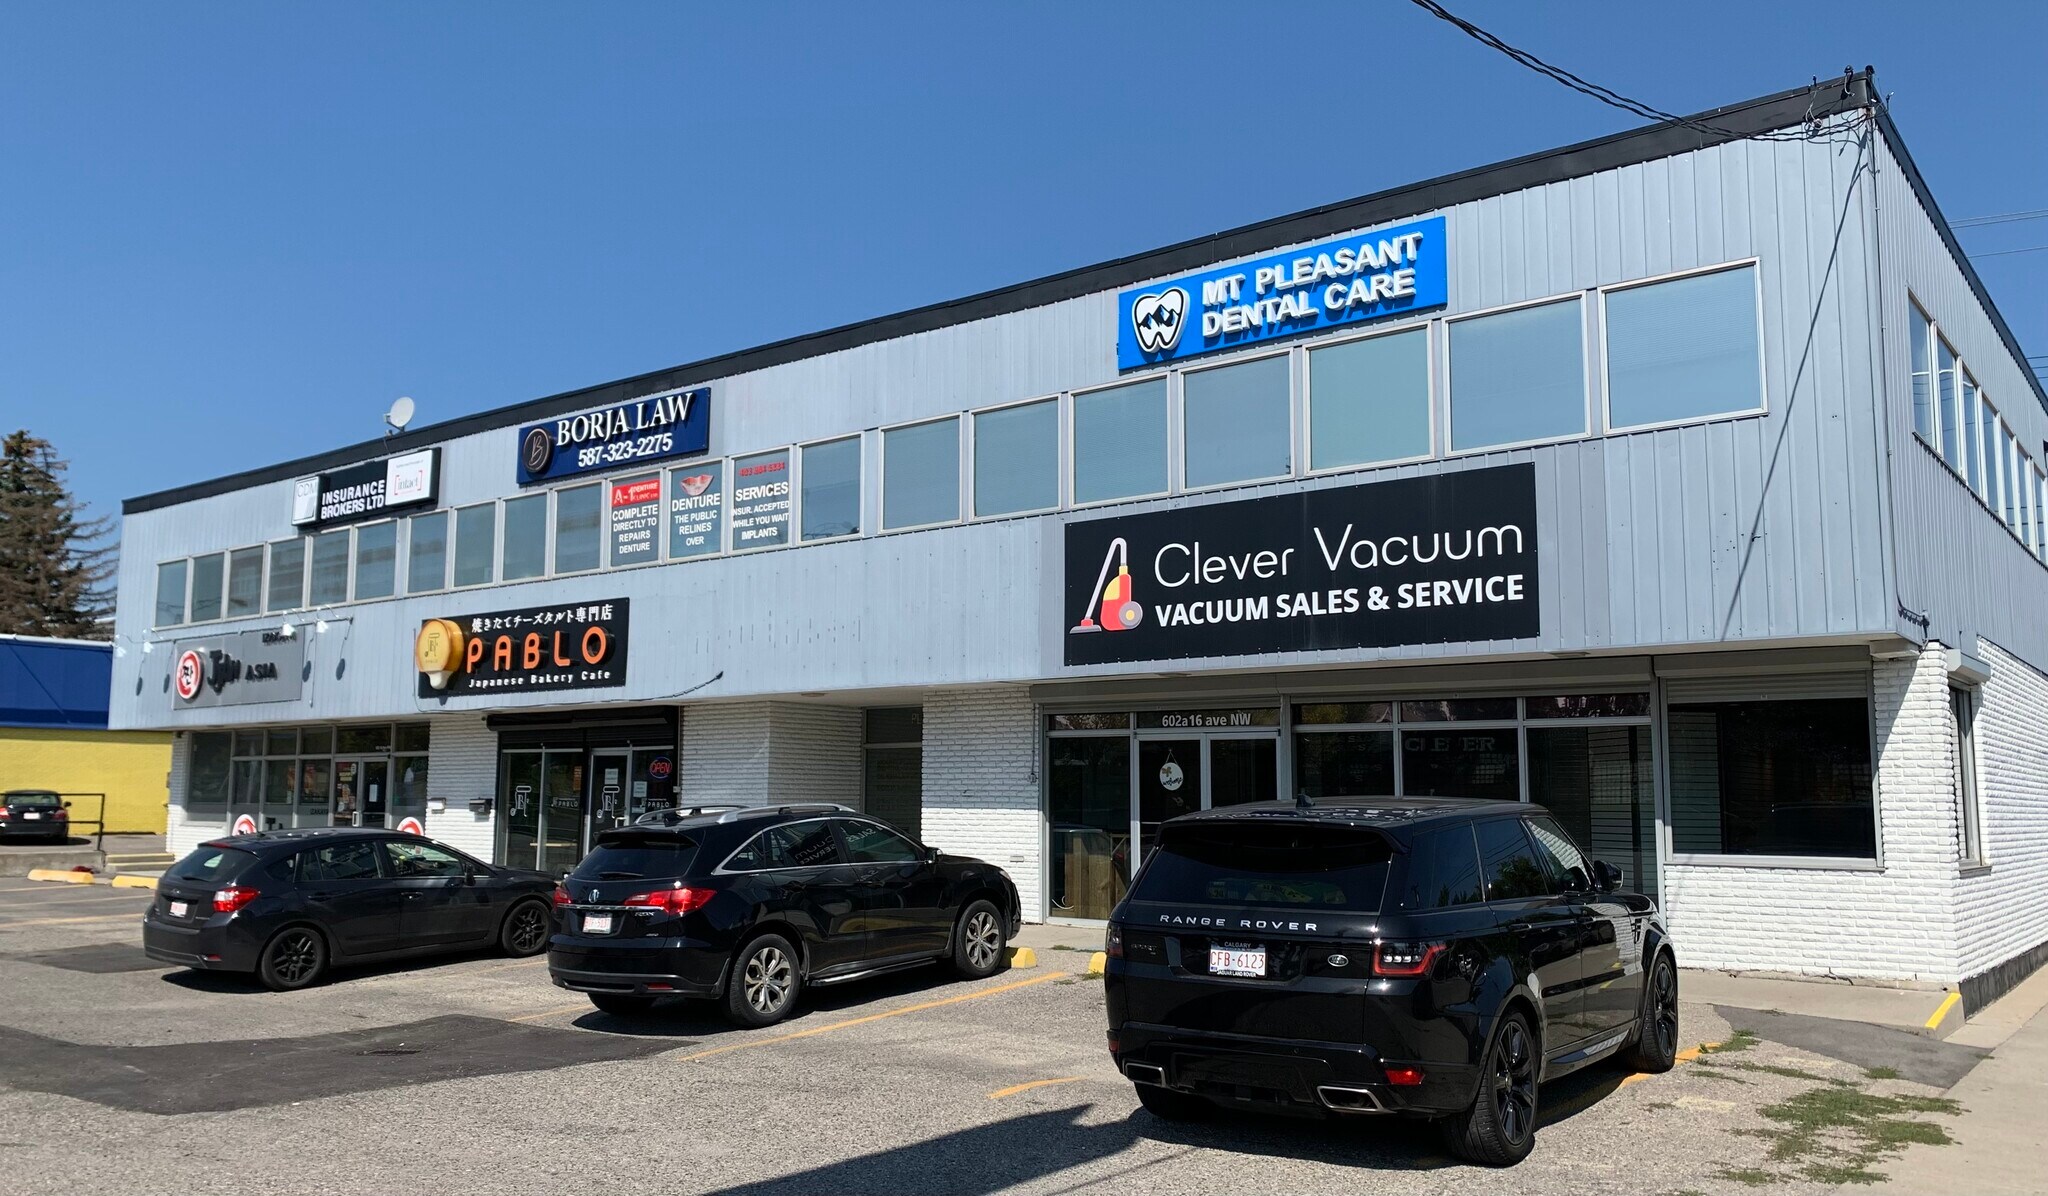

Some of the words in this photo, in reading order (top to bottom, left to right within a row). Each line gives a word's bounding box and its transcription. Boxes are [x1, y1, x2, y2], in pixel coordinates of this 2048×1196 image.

[1202, 273, 1246, 306] MT
[1255, 231, 1423, 295] PLEASANT
[1202, 289, 1319, 338] DENTAL
[1324, 267, 1416, 310] CARE
[556, 407, 630, 446] BORJA
[635, 393, 693, 430] LAW
[578, 432, 673, 468] 587-323-2275
[322, 480, 385, 505] INSURANCE
[735, 481, 789, 502] SERVICES
[321, 499, 365, 520] BROKERS
[366, 495, 384, 510] LTD
[672, 493, 720, 512] DENTURE
[754, 500, 789, 513] ACCEPTED
[612, 504, 658, 521] COMPLETE
[674, 515, 689, 524] THE
[690, 510, 717, 522] PUBLIC
[732, 518, 755, 528] WHILE
[755, 516, 771, 525] YOU
[771, 512, 789, 522] WAIT
[613, 519, 646, 532] DIRECTLY
[647, 517, 657, 526] TO
[679, 522, 712, 535] RELINES
[741, 527, 778, 540] IMPLANTS
[618, 530, 651, 543] REPAIRS
[685, 536, 704, 546] OVER
[619, 542, 650, 554] DENTURE
[1154, 541, 1295, 587] Clever
[1313, 523, 1523, 572] Vacuum
[1155, 597, 1269, 628] VACUUM
[1276, 588, 1359, 618] SALES
[1367, 586, 1390, 610] &
[1398, 574, 1524, 609] SERVICE
[472, 603, 613, 633] 焼きたてチーズタルト専門店
[466, 626, 608, 674] PABLO
[245, 662, 278, 681] ASIA
[469, 676, 524, 689] Japanese
[530, 673, 574, 685] Bakery
[581, 670, 611, 681] Cafe
[1205, 716, 1227, 726] ave
[1230, 713, 1251, 726] NW
[652, 761, 671, 774] OPEN
[1160, 914, 1226, 927] RANGE
[1240, 919, 1318, 932] ROVER
[1210, 951, 1265, 969] CFB-6123
